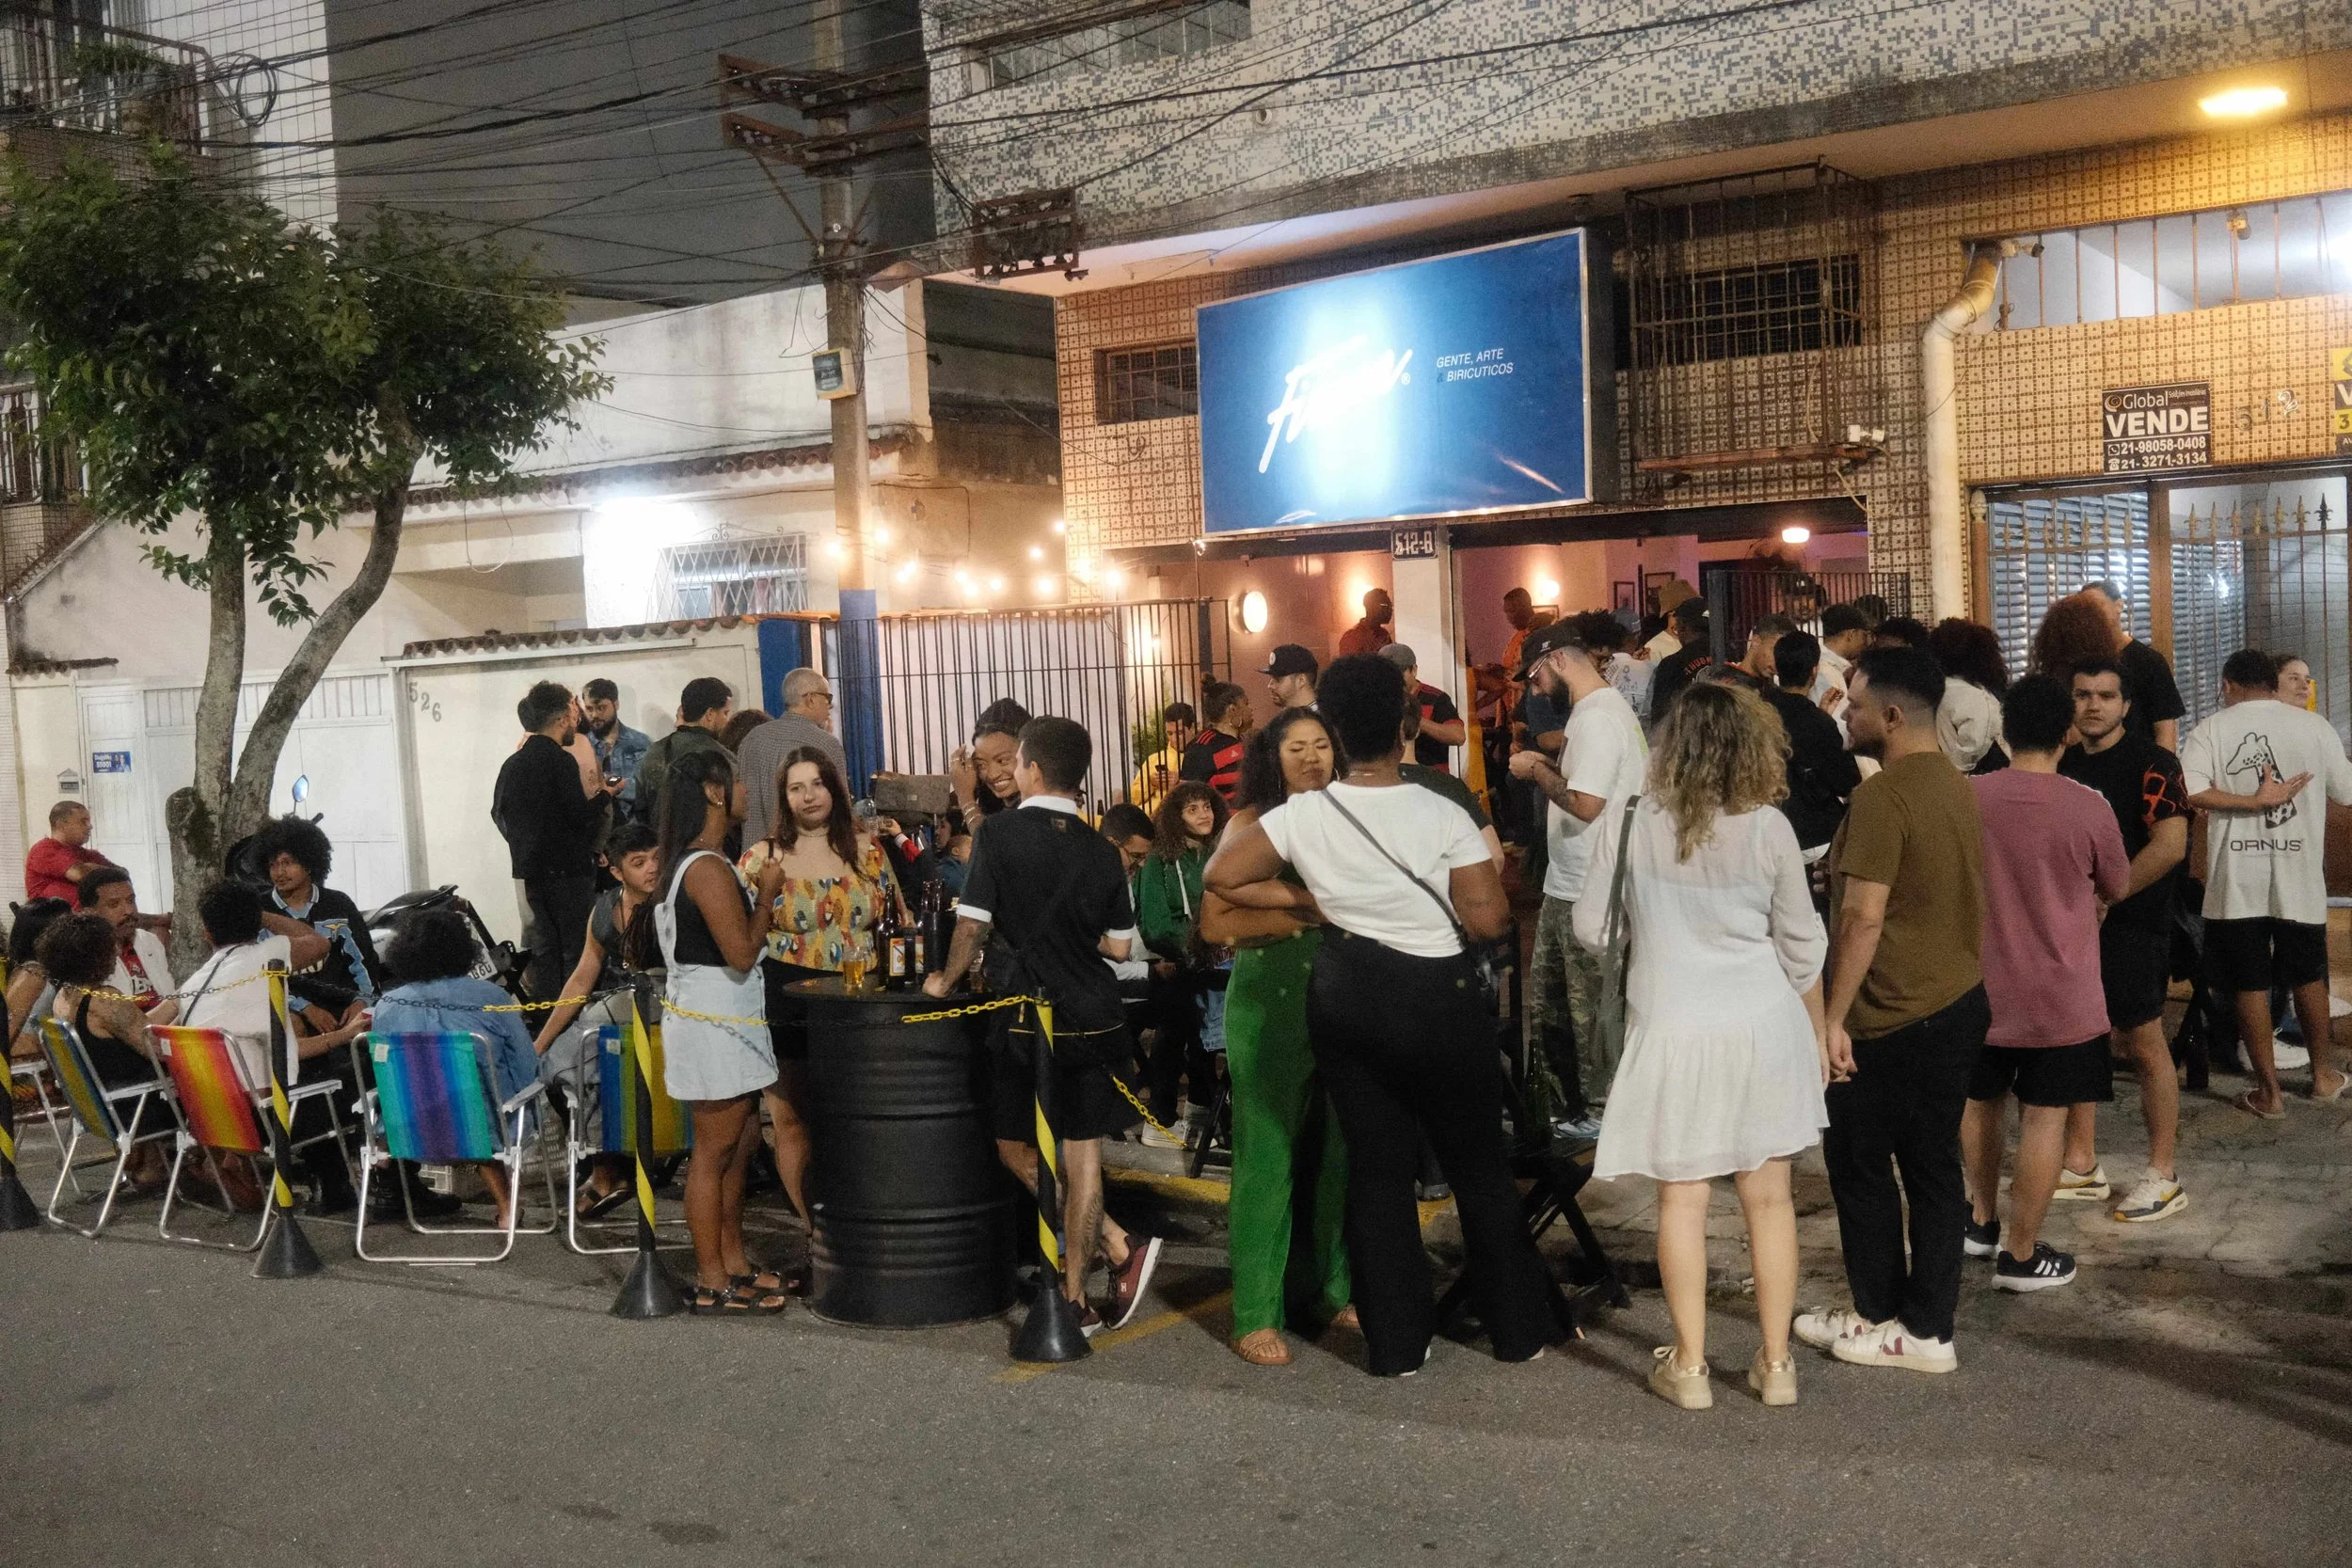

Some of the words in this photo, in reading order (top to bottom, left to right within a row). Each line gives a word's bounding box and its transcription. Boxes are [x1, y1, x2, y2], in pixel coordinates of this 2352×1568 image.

[1436, 353, 1473, 368] GENTE,
[1476, 348, 1504, 362] ARTE
[1446, 362, 1514, 382] BIRICUTICOS
[2122, 390, 2169, 409] Global
[2106, 406, 2209, 437] VENDE
[2122, 436, 2206, 455] 21-98058-0408
[409, 681, 442, 722] 526
